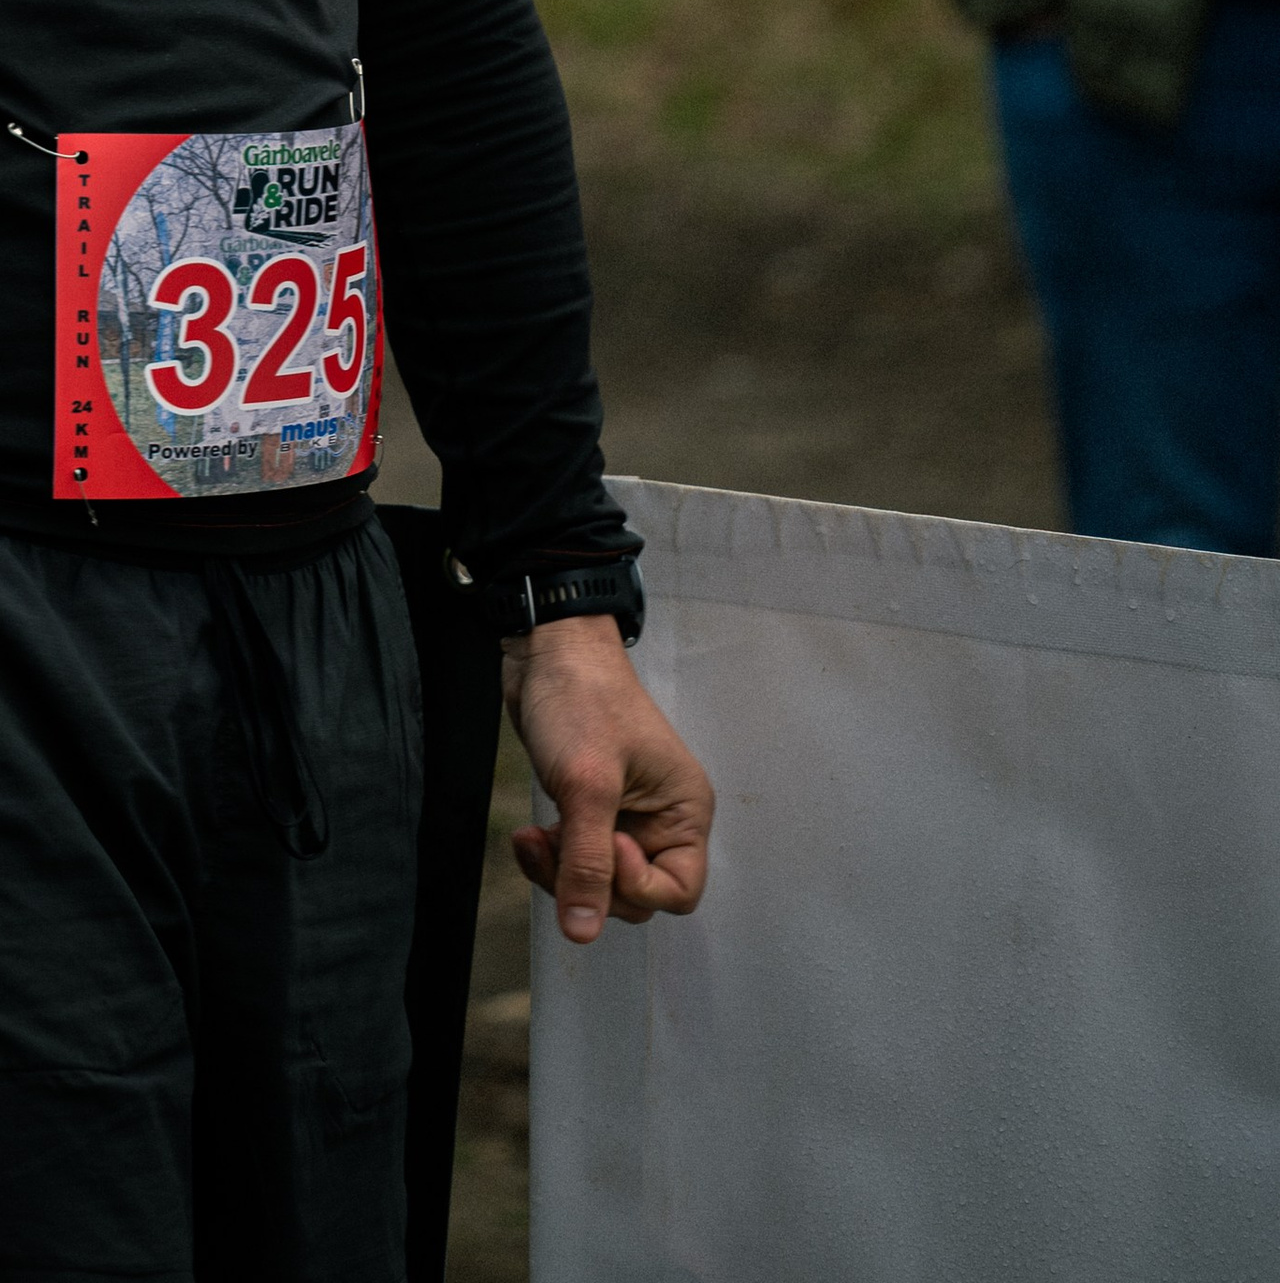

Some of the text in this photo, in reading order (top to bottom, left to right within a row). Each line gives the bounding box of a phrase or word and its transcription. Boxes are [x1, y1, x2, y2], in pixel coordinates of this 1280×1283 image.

[243, 139, 341, 167] Gârboavele
[277, 163, 340, 198] RUN
[264, 183, 283, 209] &
[274, 193, 338, 229] RIDE
[77, 174, 91, 278] TRAIL
[76, 309, 90, 368] RUN
[147, 242, 367, 413] 325
[71, 400, 93, 414] 24
[280, 435, 337, 452] BKE
[281, 417, 338, 443] maus
[148, 438, 259, 460] Powered by
